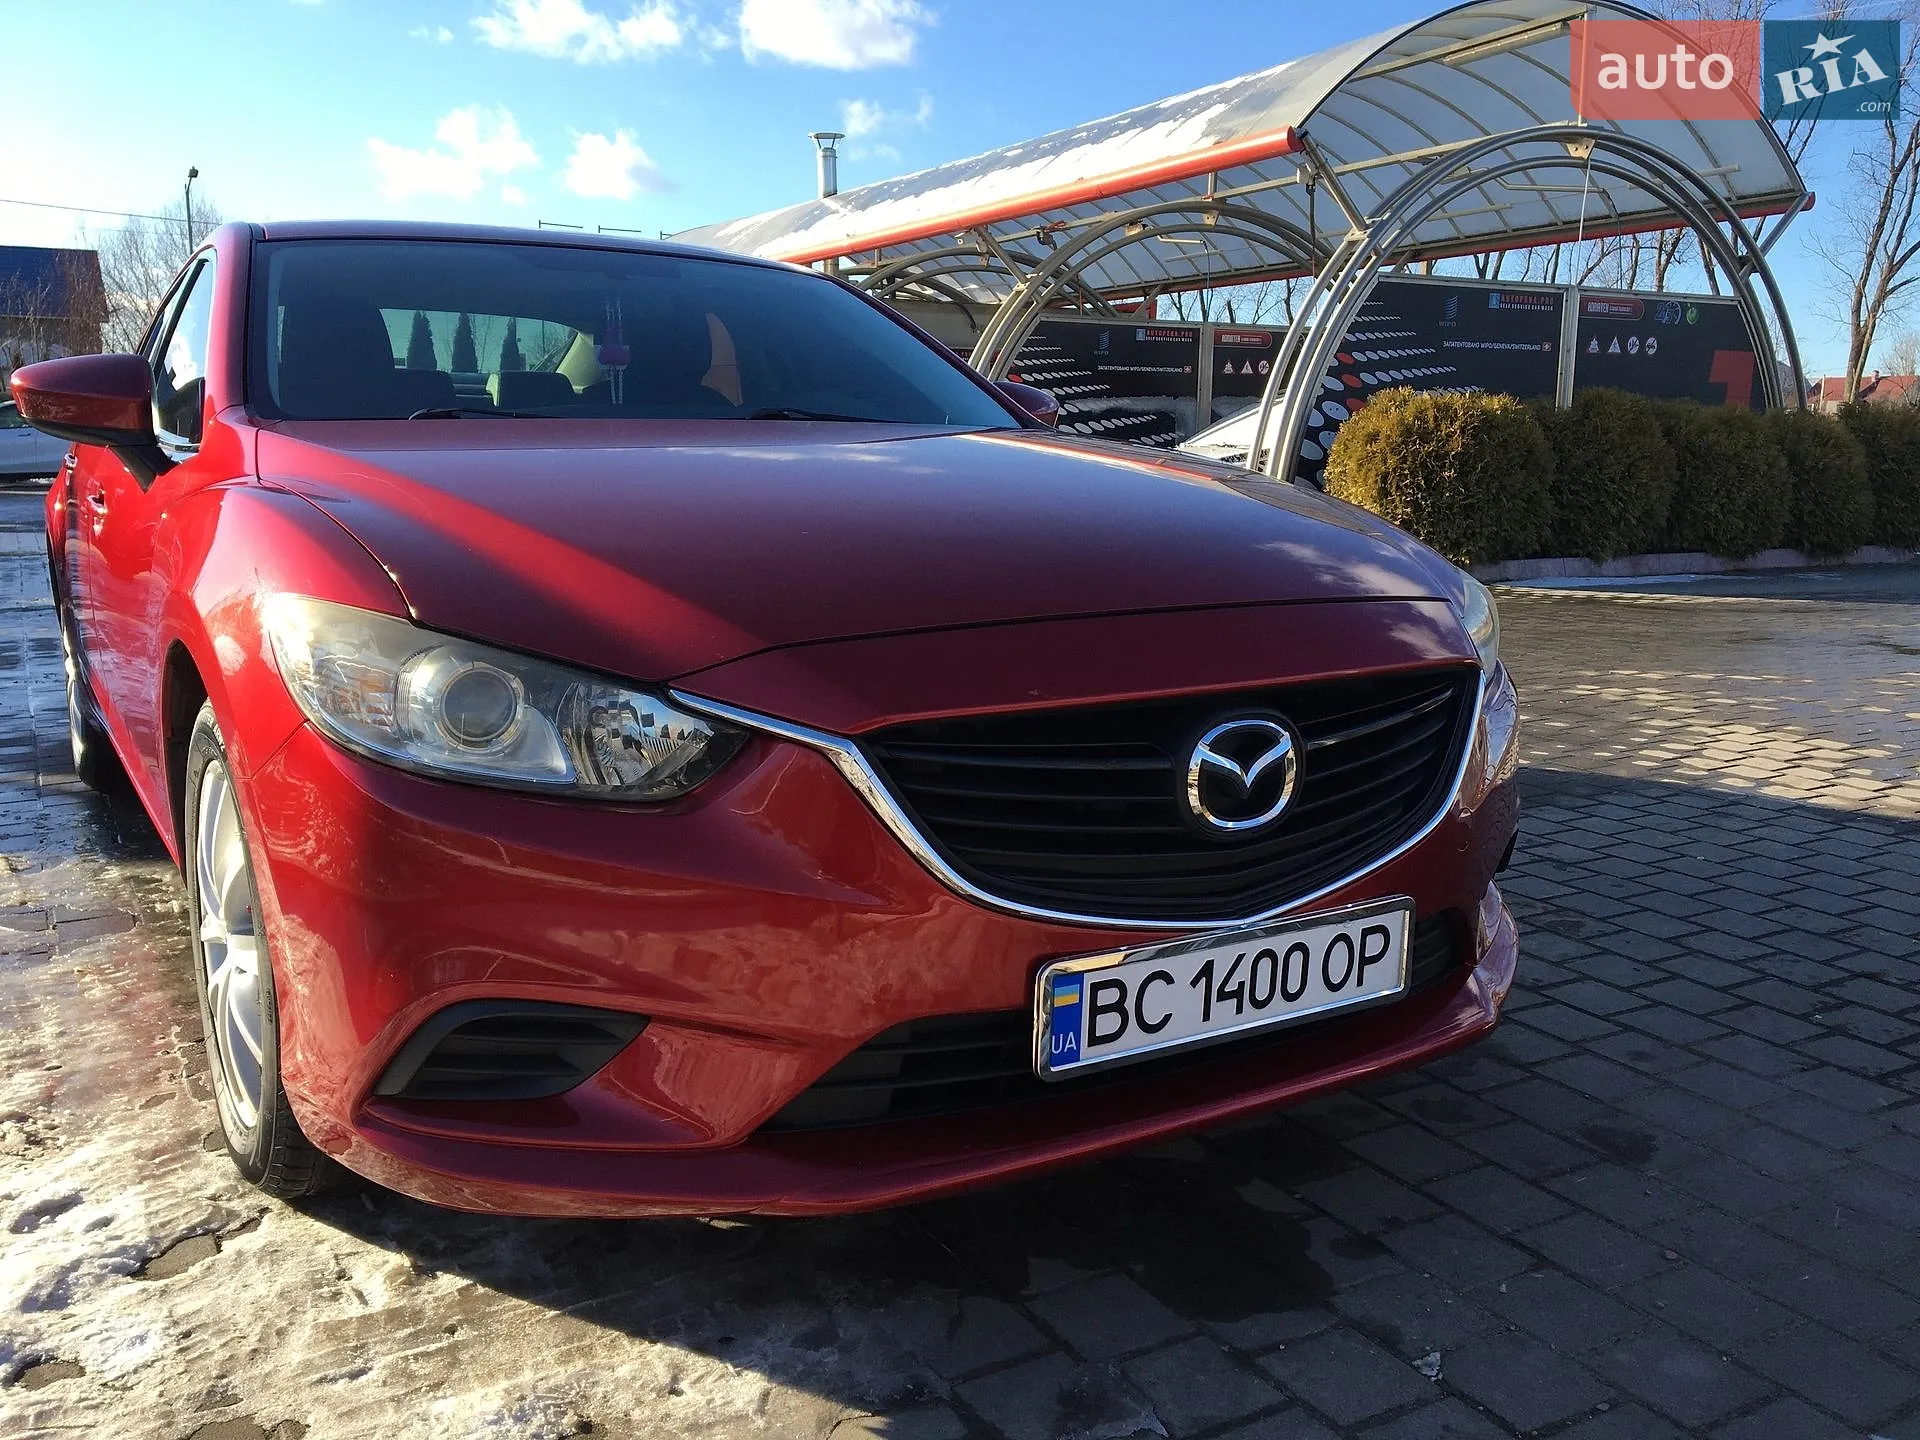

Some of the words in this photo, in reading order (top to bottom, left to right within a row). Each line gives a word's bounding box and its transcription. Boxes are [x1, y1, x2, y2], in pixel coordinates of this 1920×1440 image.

[1087, 969, 1175, 1048] BC
[1190, 942, 1310, 1022] 1400
[1322, 924, 1391, 993] OP
[1051, 1030, 1077, 1054] UA
